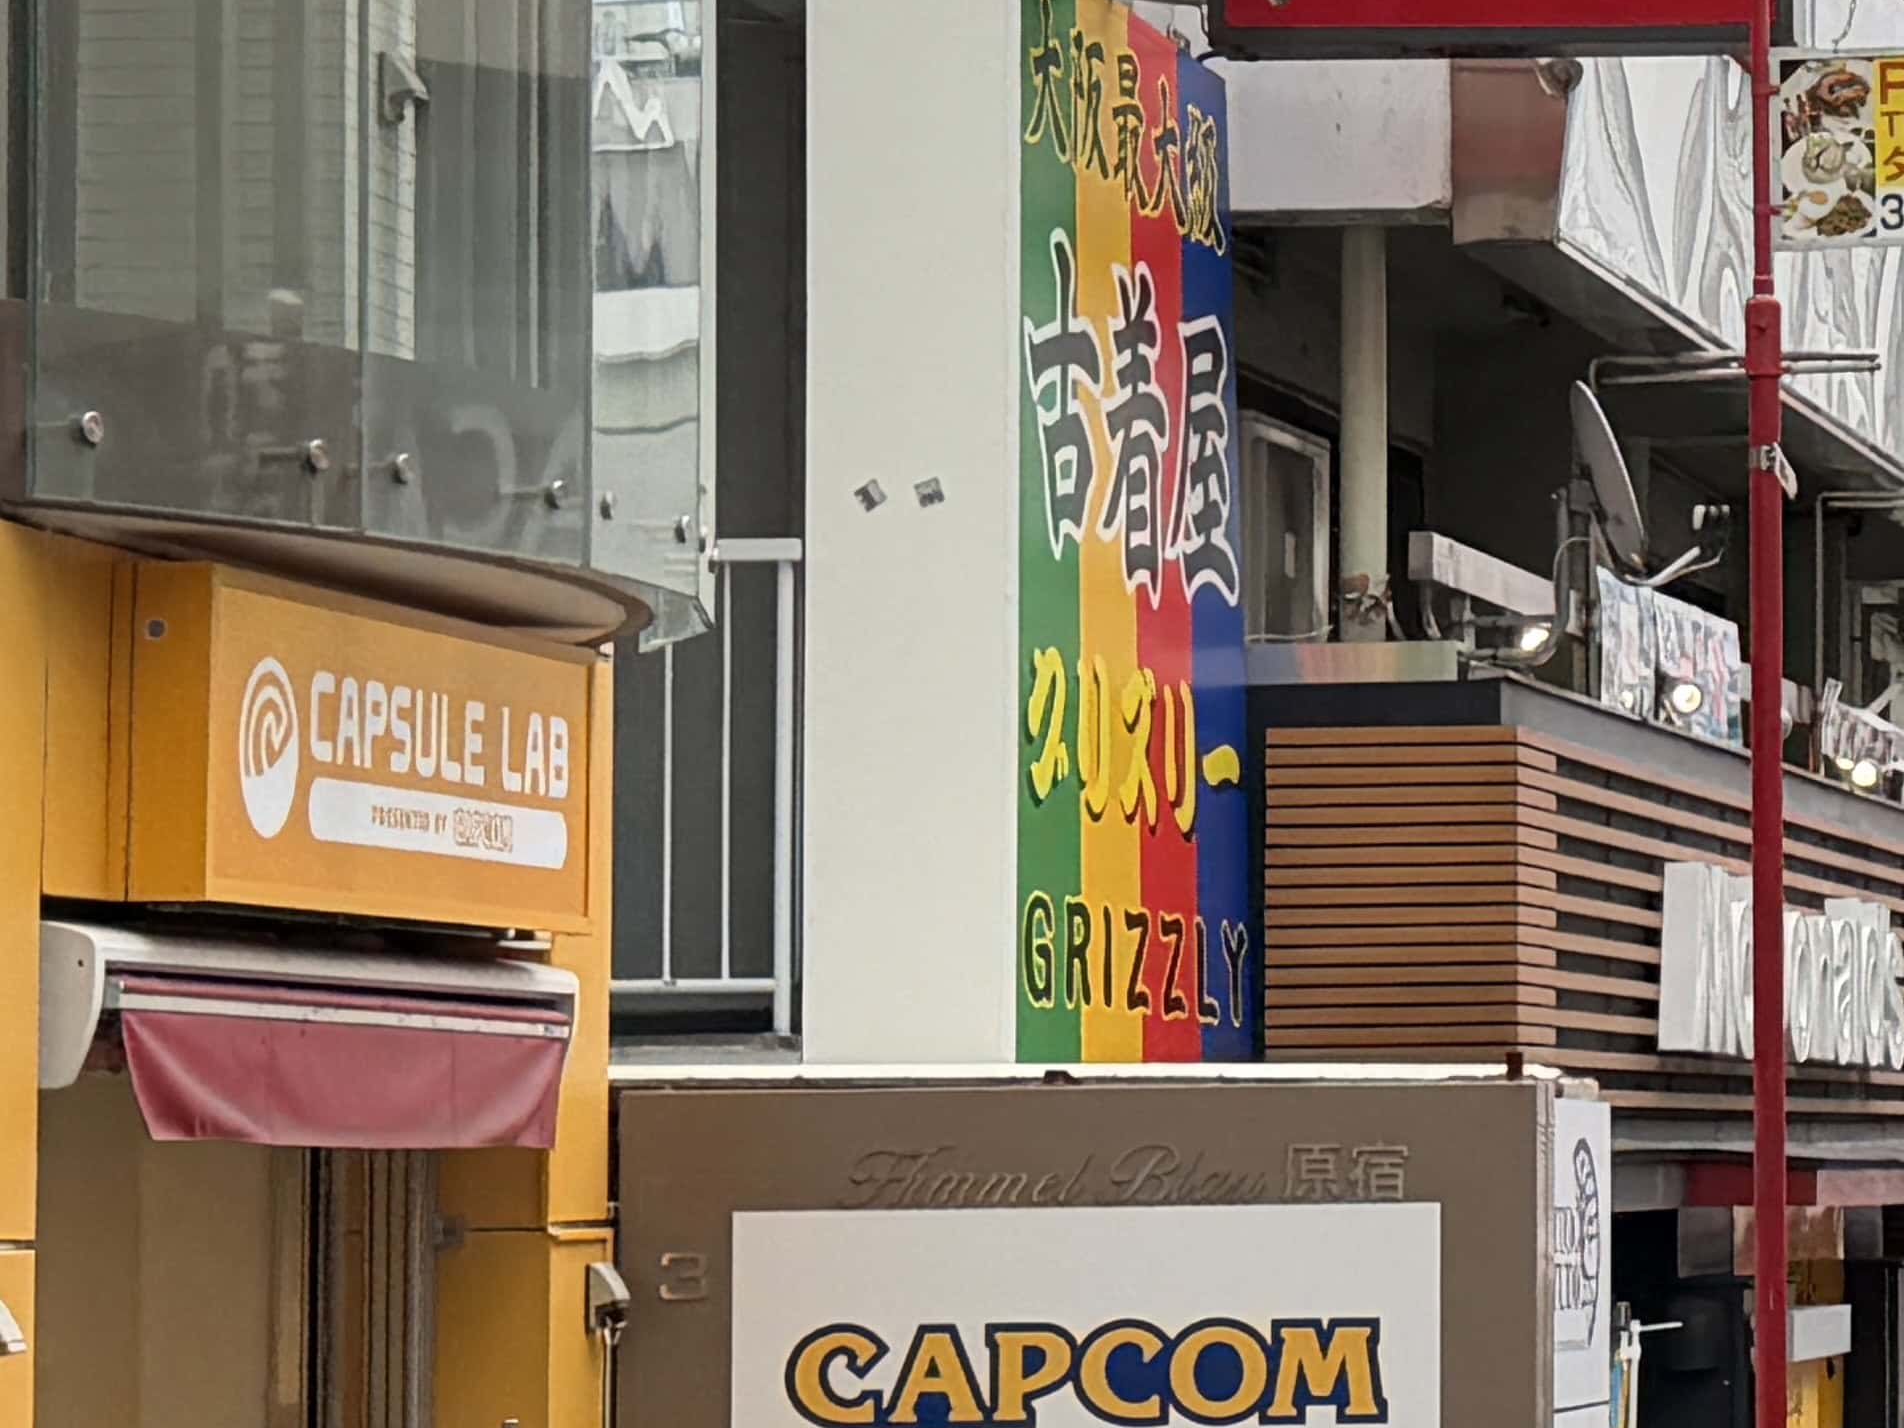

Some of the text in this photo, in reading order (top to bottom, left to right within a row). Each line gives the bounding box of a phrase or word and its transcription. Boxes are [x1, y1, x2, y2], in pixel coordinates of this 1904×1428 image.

[1023, 227, 1240, 609] 古着屋
[310, 670, 570, 800] CAPSULE LAB
[1028, 644, 1242, 849] グリズリー
[1023, 891, 1250, 1030] GRIZZLY
[1282, 1141, 1409, 1200] 原宿
[658, 1250, 708, 1302] 3
